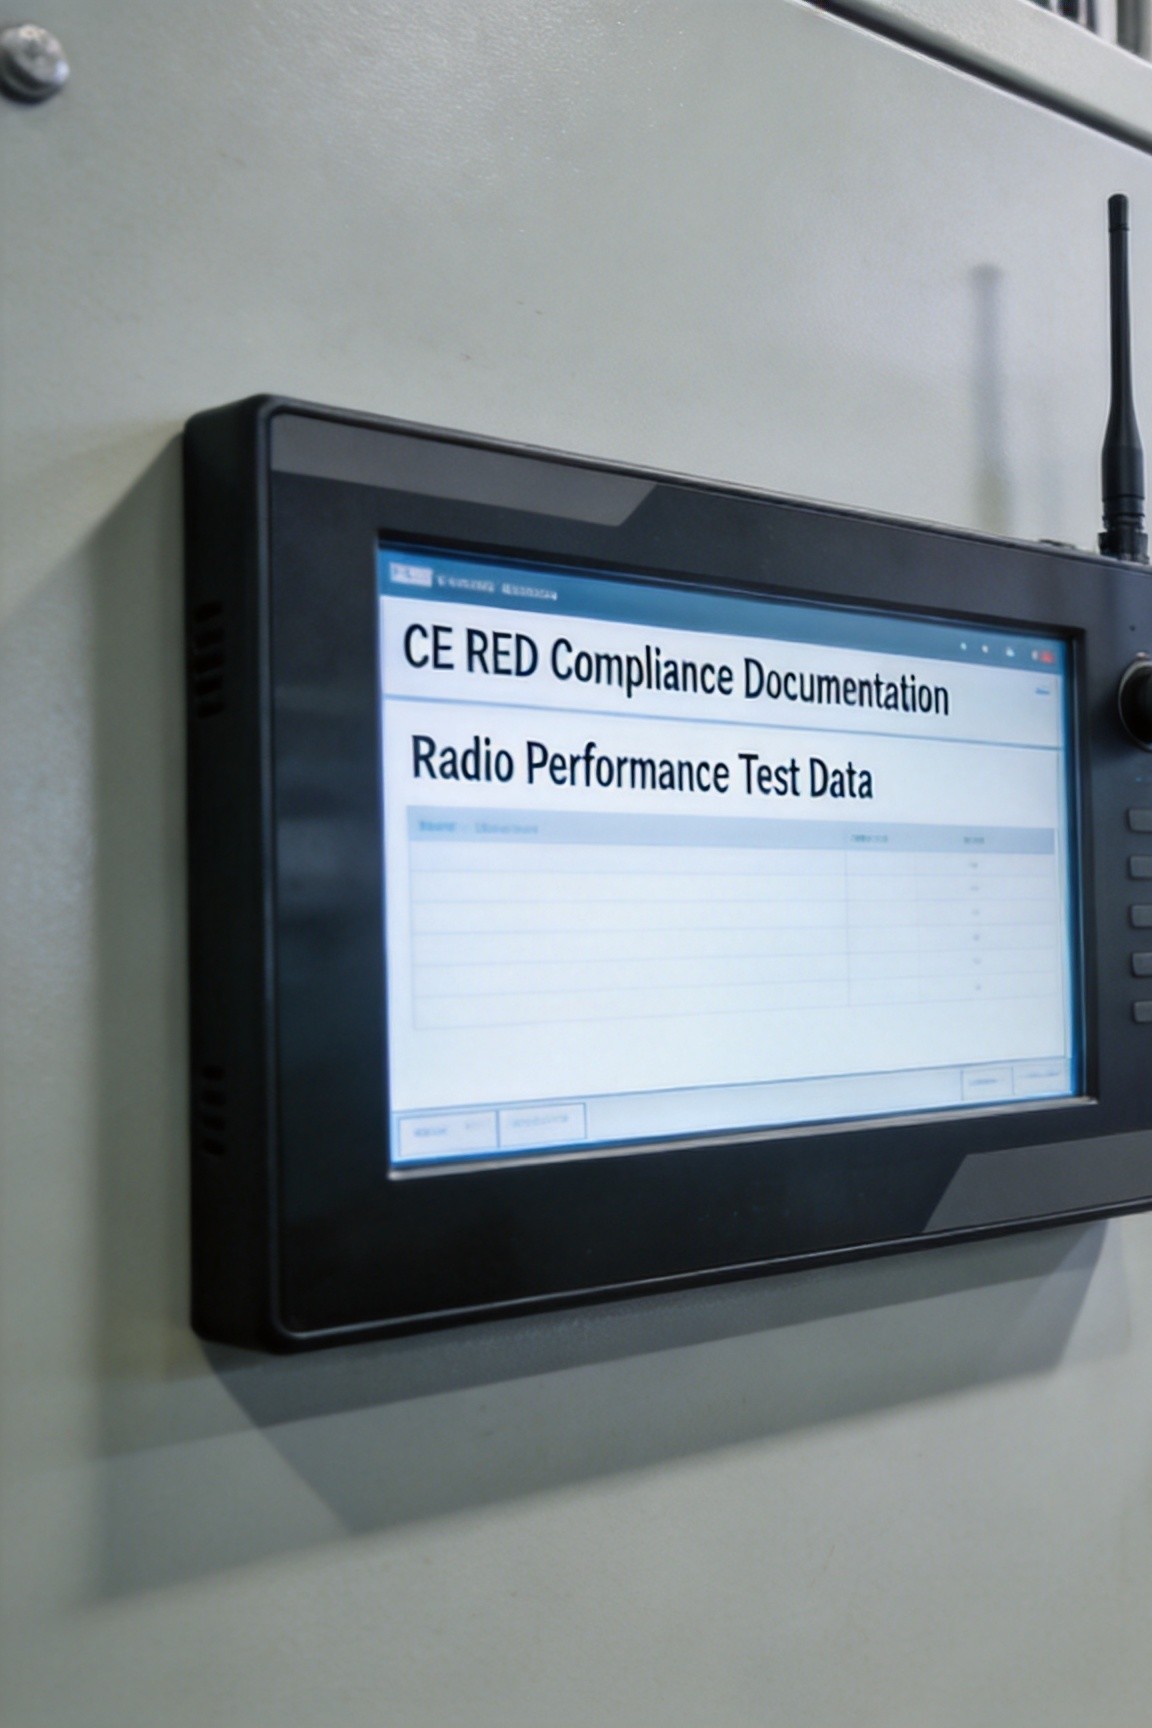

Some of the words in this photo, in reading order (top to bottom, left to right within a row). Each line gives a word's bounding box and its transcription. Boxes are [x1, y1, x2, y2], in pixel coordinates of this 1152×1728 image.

[403, 623, 455, 670] CE
[466, 628, 539, 678] RED
[550, 637, 734, 699] Compliance
[744, 657, 950, 716] Documentation
[412, 734, 514, 784] Radio
[526, 740, 730, 794] Performance
[737, 753, 801, 798] Test
[809, 757, 874, 800] Data
